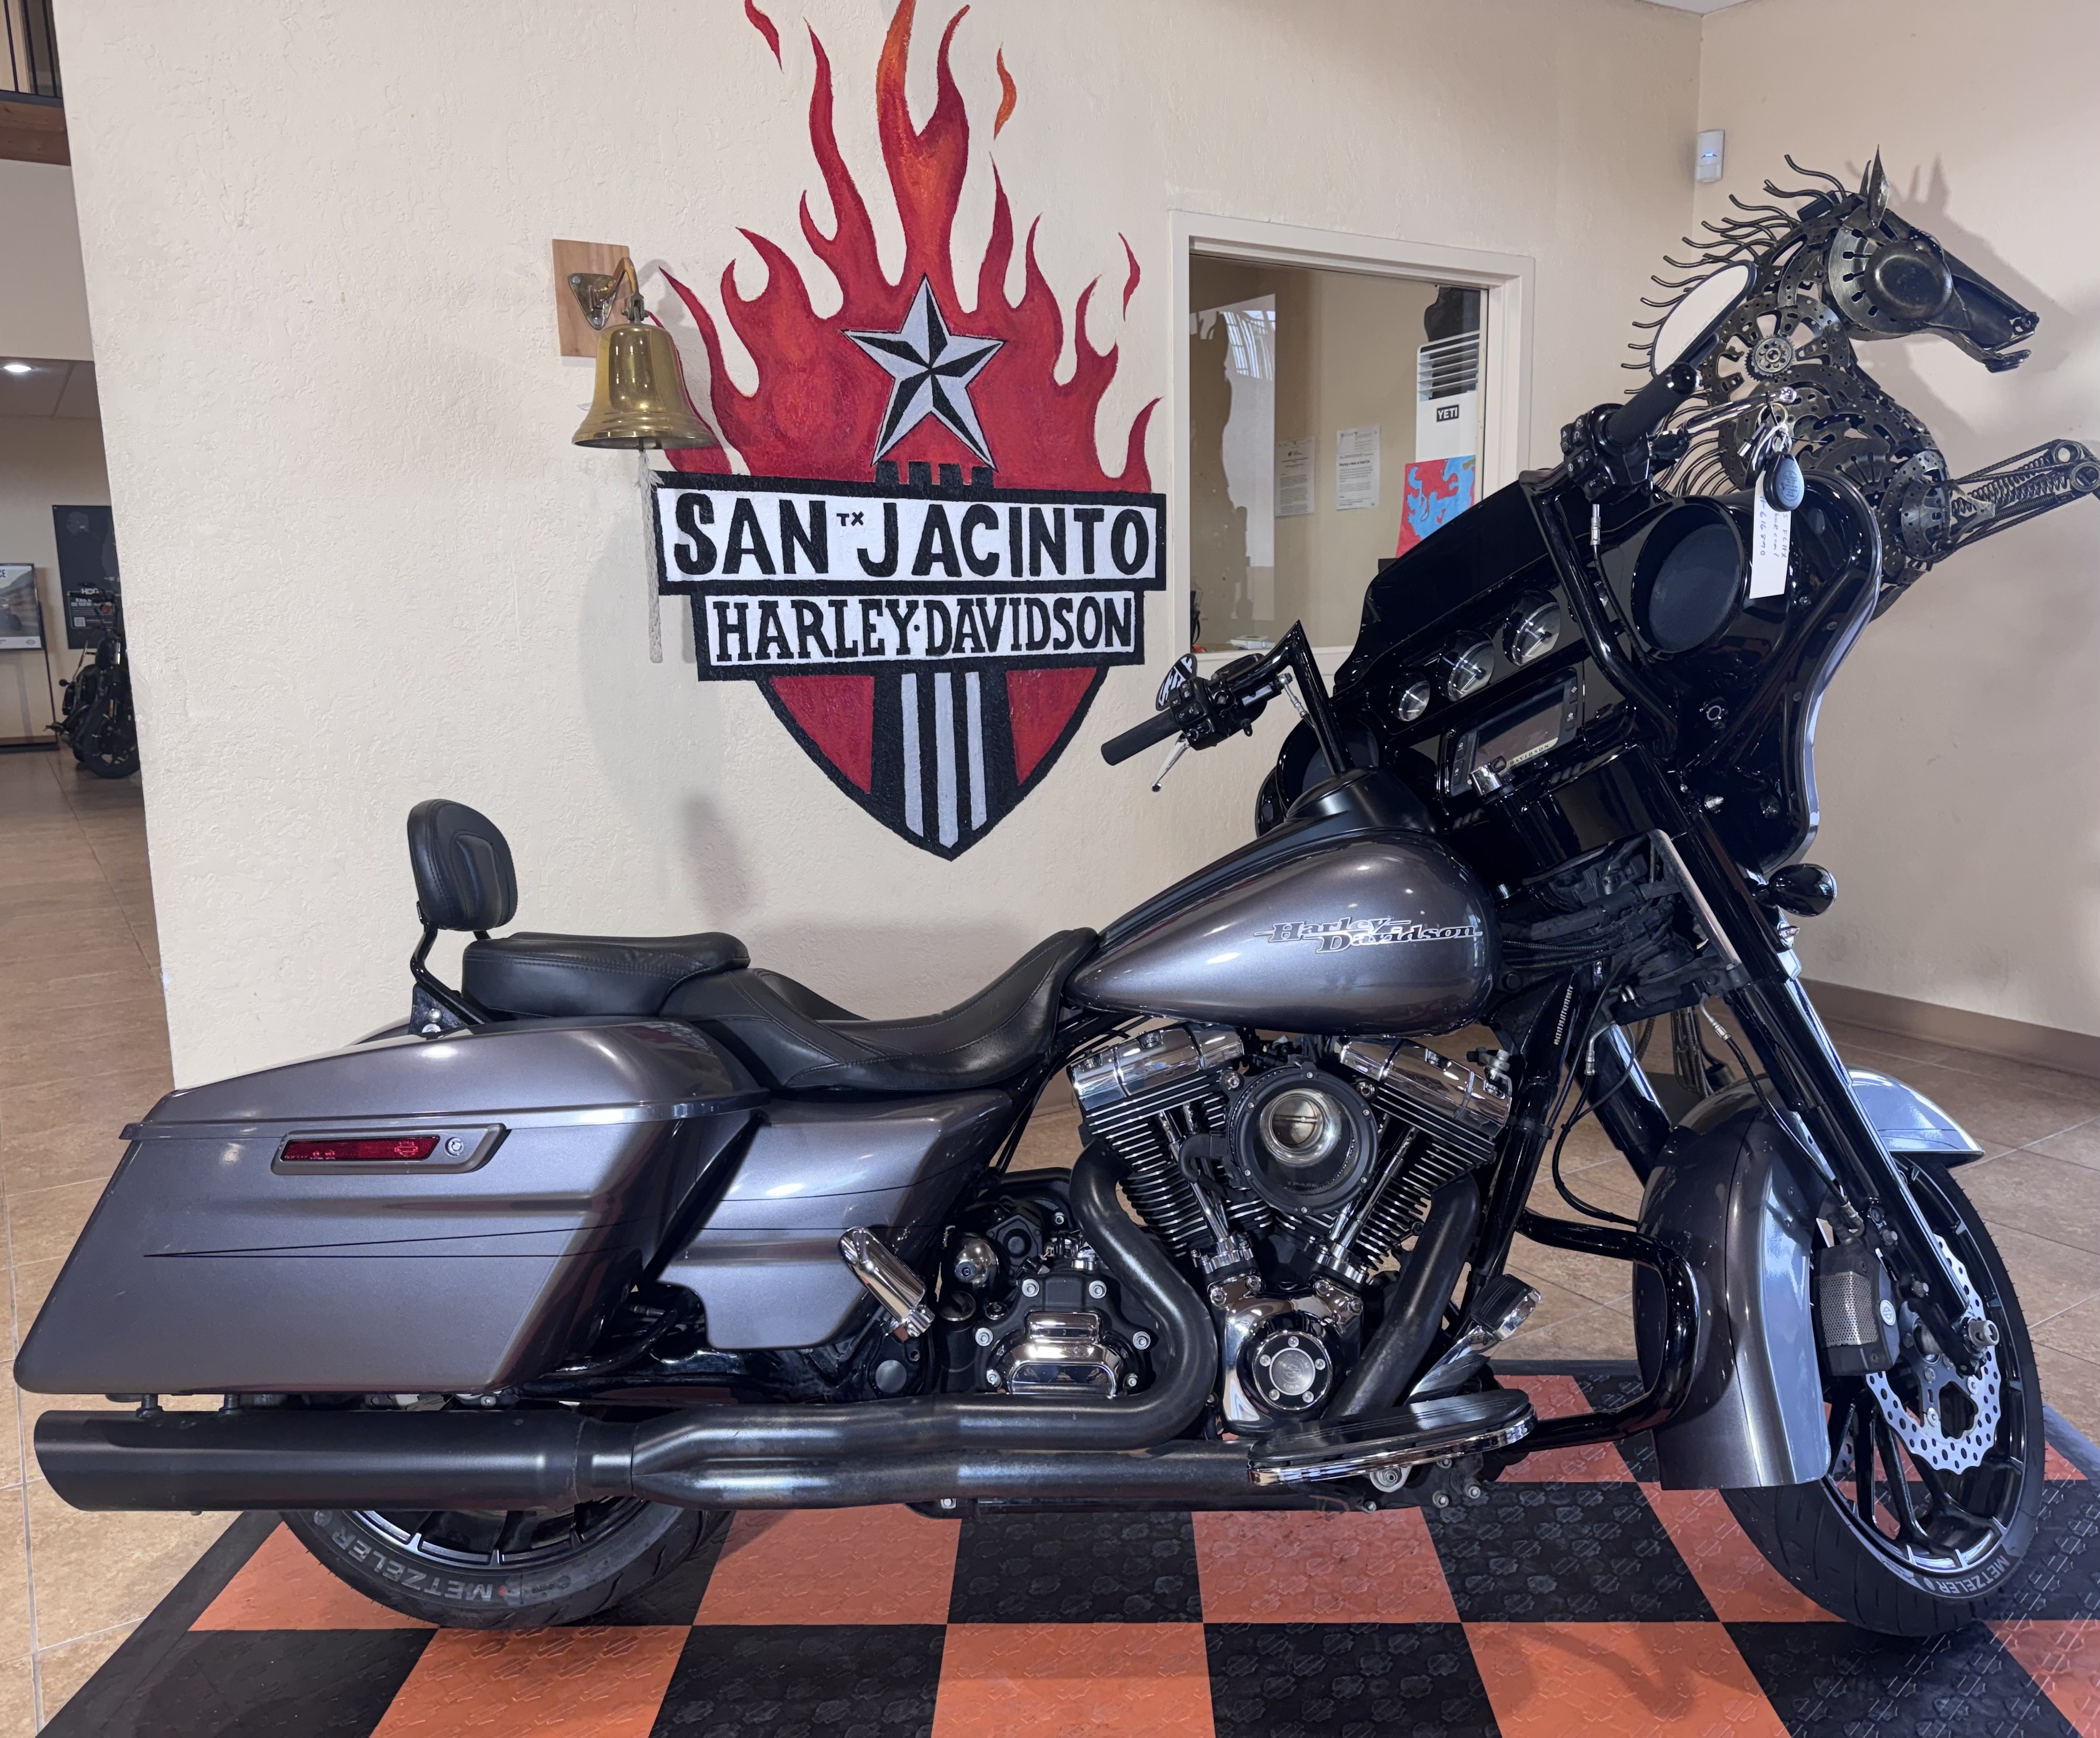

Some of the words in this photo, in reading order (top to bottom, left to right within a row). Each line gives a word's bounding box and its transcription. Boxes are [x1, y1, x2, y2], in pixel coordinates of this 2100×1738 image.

[1437, 407, 1457, 420] YETI
[674, 493, 829, 575] SAN
[836, 512, 864, 528] TX
[857, 502, 1148, 578] JACINTO
[1509, 744, 1549, 766] DAVIDSON
[1256, 916, 1406, 943] Harley
[1315, 924, 1483, 953] Davidson
[332, 1528, 493, 1602] METZELER
[1937, 1554, 2010, 1595] METZELER
